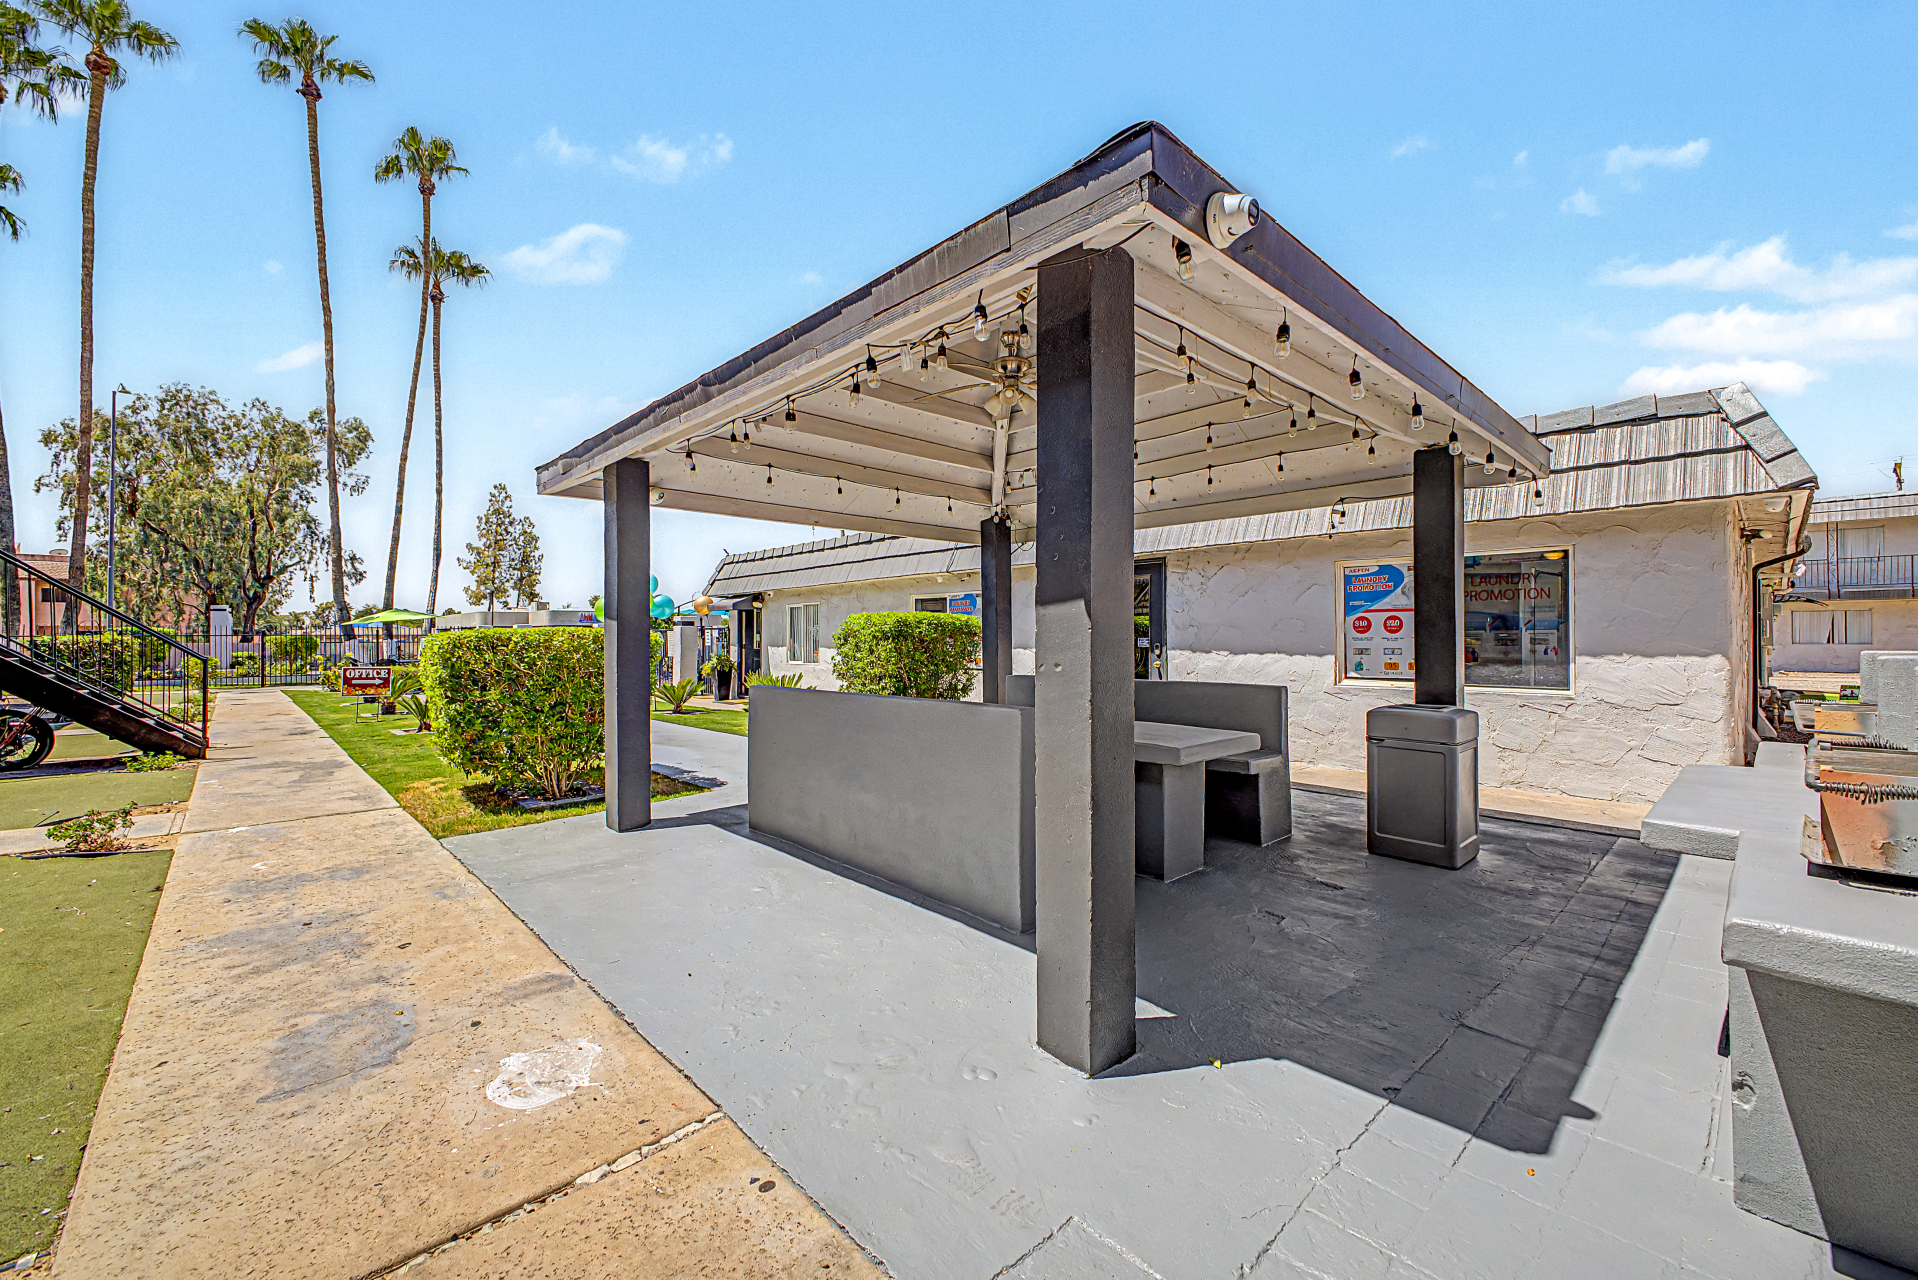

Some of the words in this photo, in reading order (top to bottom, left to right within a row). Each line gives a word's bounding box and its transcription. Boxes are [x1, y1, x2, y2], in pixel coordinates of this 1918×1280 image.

[1352, 575, 1388, 585] LAUNDRY
[1471, 571, 1540, 587] LAUNDRY
[1347, 583, 1394, 592] PROMOTION
[345, 669, 389, 678] OFFICE
